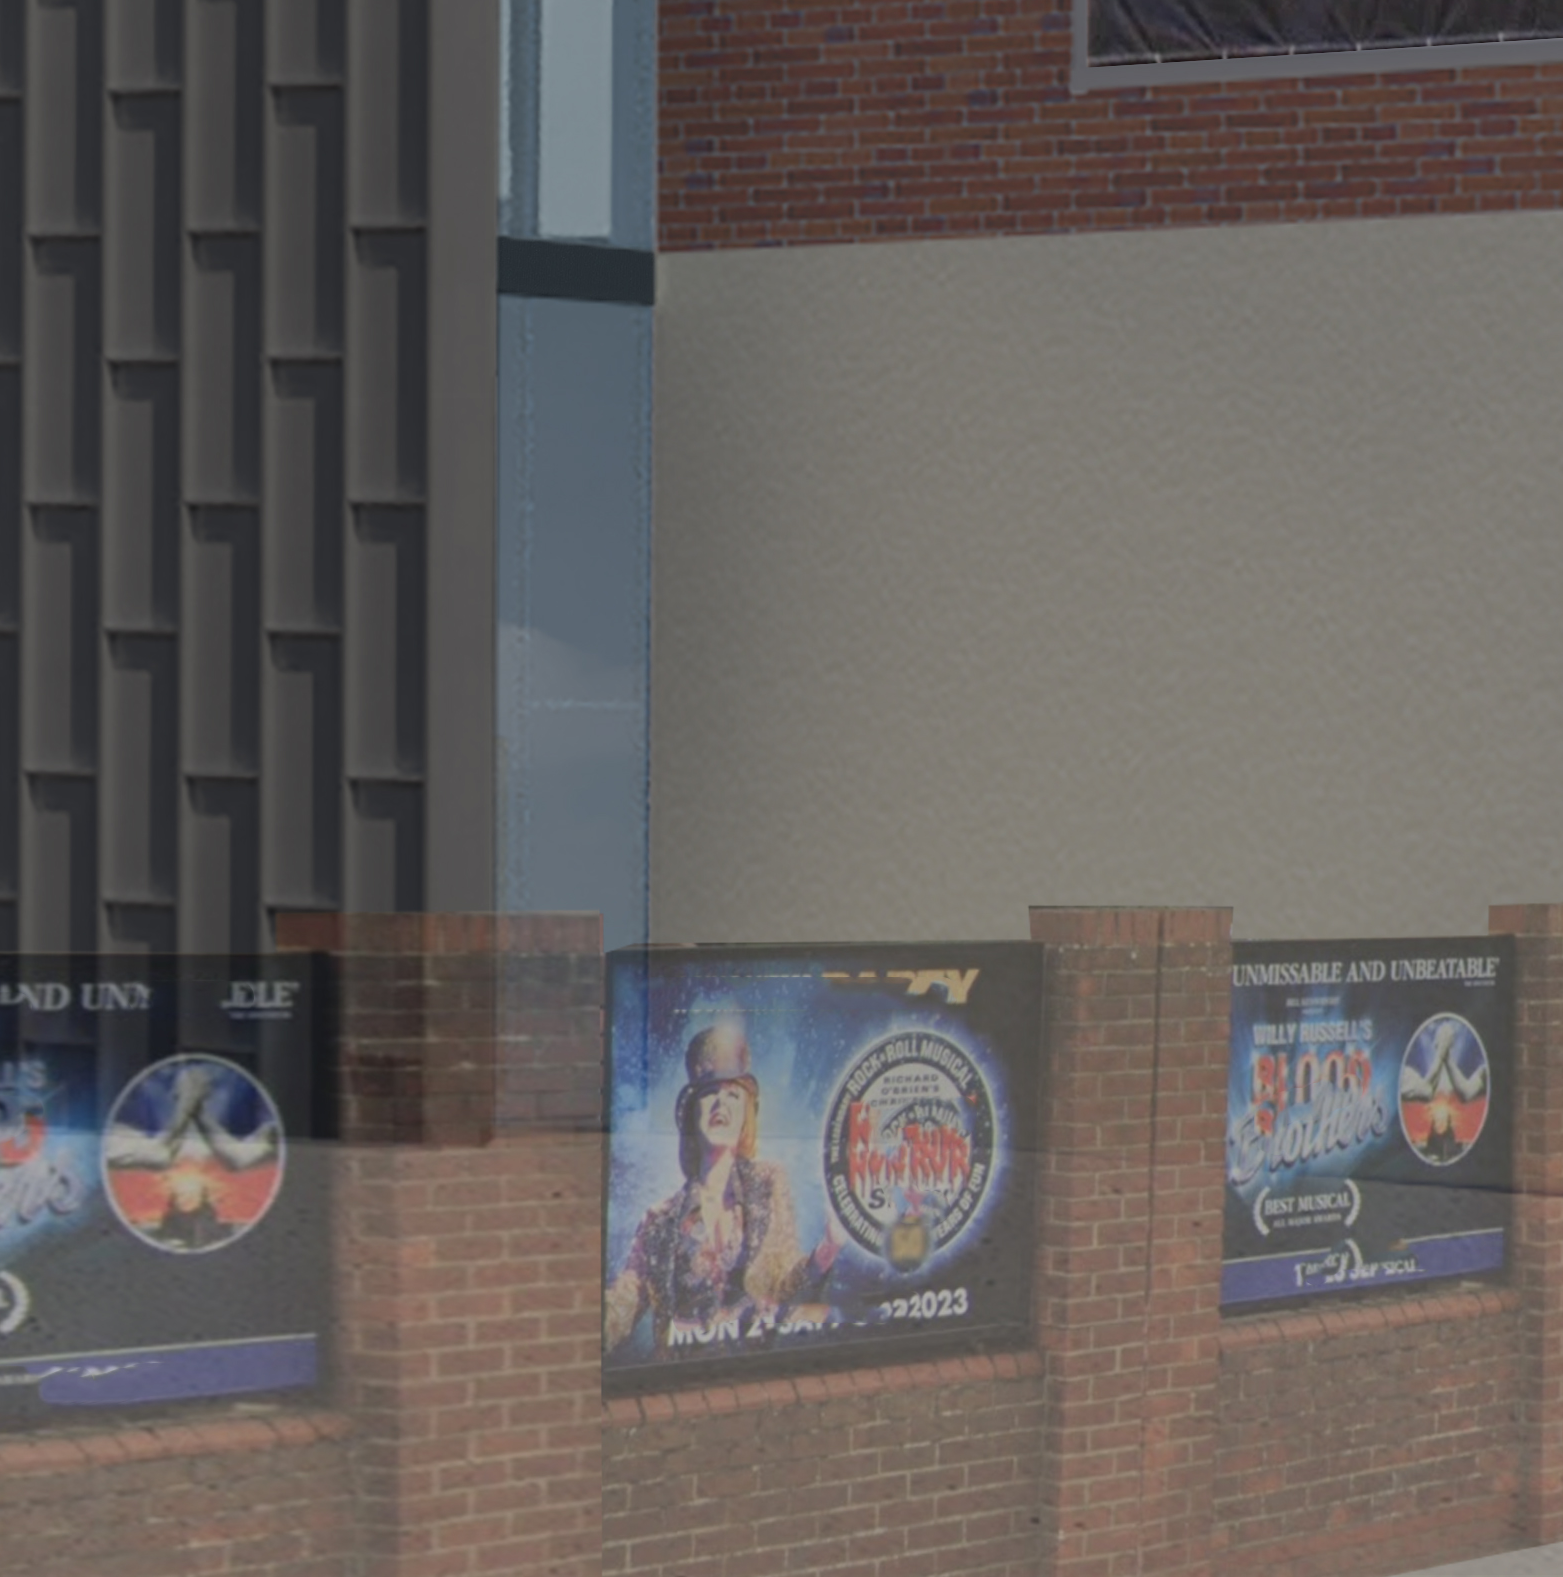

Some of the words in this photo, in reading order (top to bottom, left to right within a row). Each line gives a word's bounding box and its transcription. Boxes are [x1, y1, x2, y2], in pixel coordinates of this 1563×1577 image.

[1232, 961, 1342, 987] UNMISSABLE
[1346, 960, 1386, 983] AND
[921, 1039, 974, 1091] MUSICAL
[1264, 1197, 1296, 1216] BEST
[1298, 1191, 1351, 1213] MUSICAL
